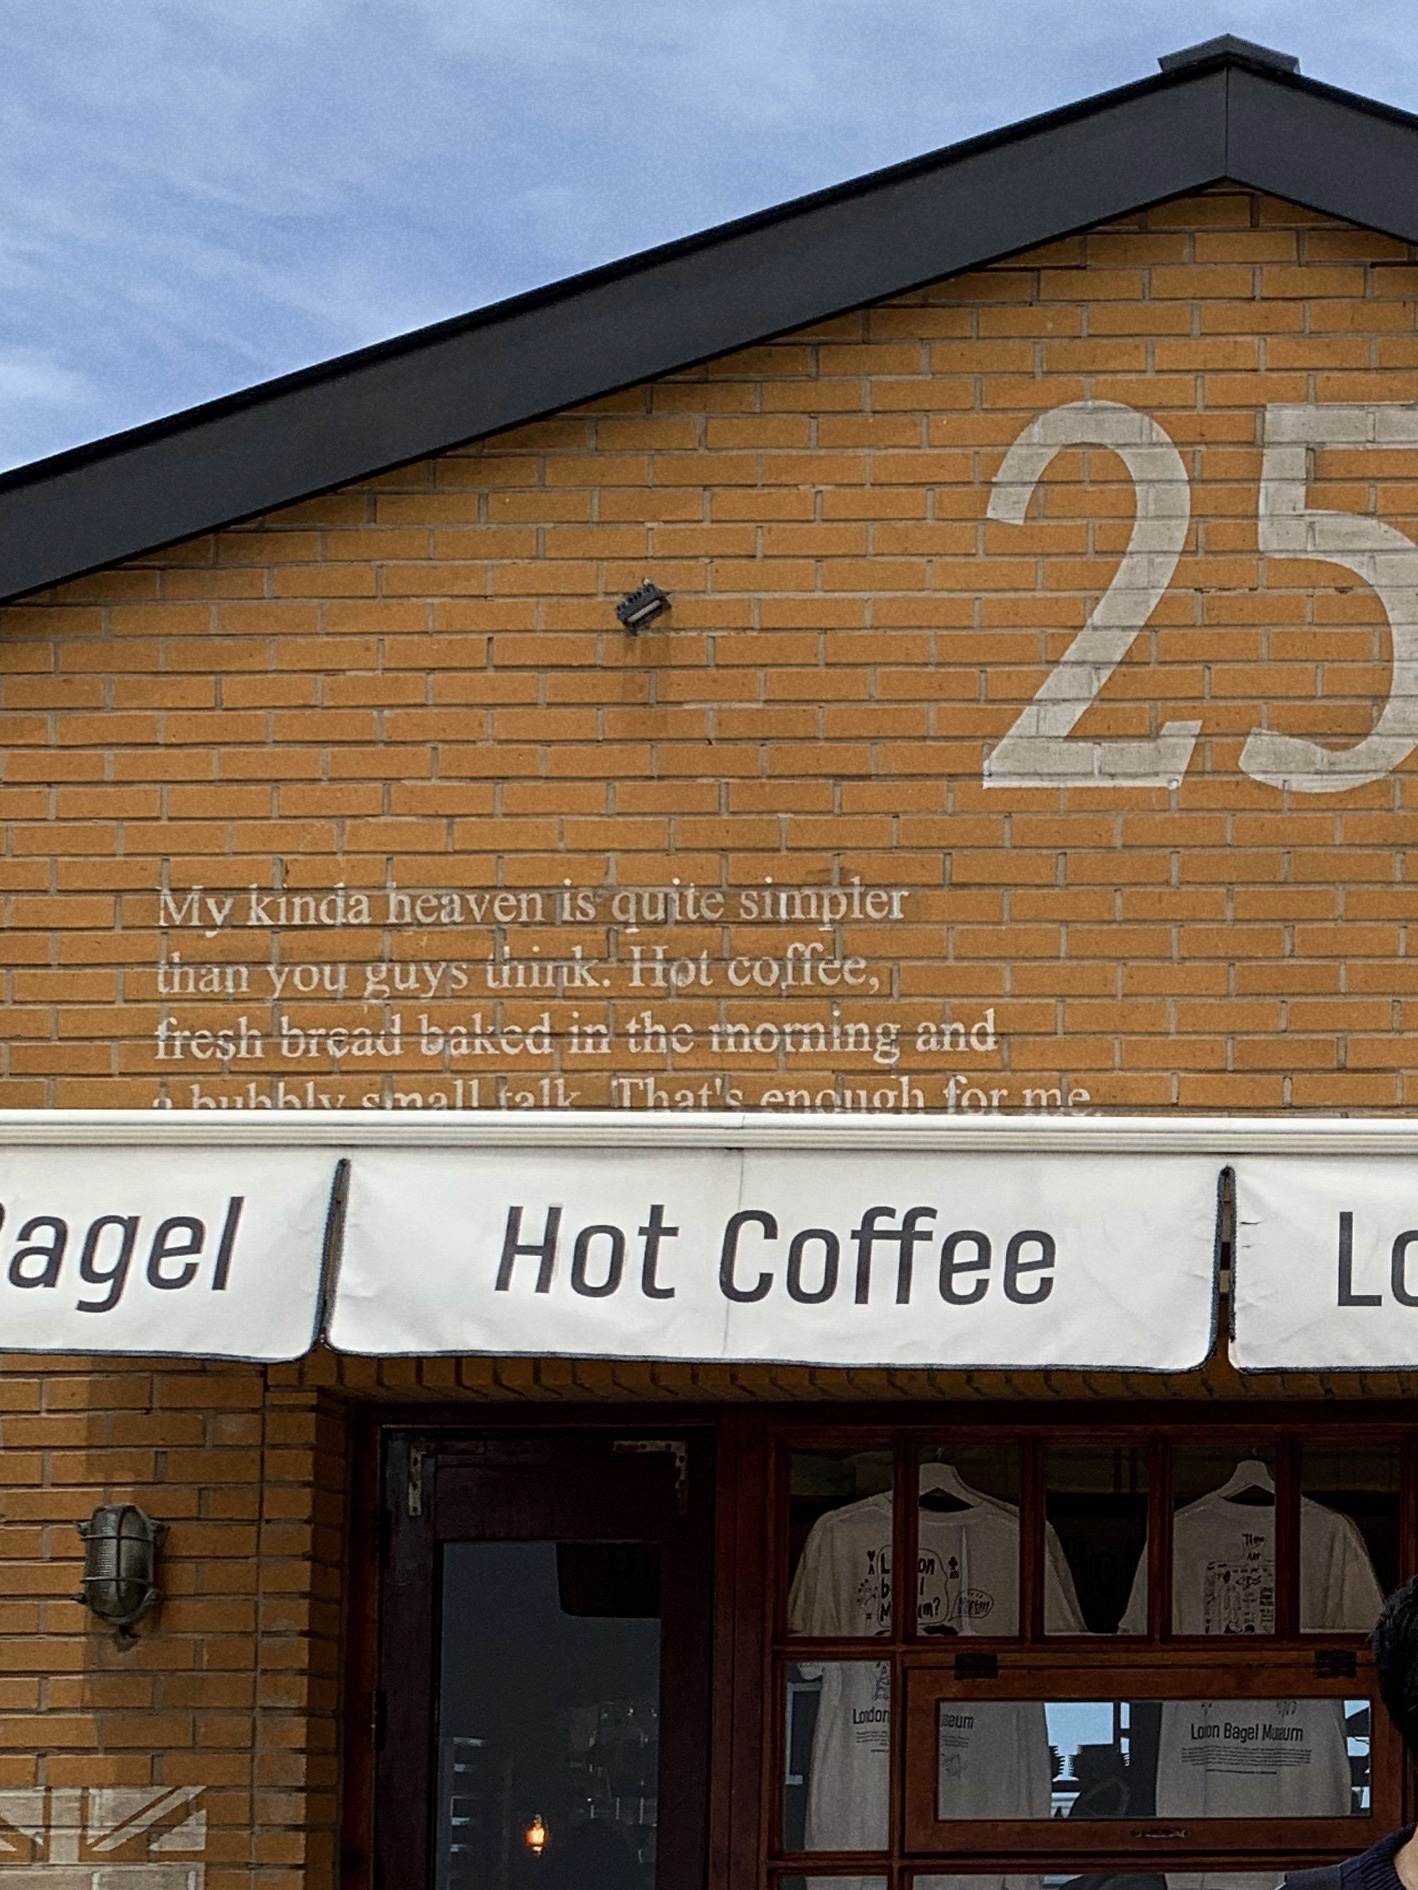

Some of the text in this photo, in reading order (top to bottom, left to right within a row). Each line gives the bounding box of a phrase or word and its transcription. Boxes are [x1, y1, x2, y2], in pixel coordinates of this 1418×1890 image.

[158, 875, 910, 937] My kinda heaven is quite simpler
[157, 941, 881, 1002] than you guys think. Hot coffee,
[154, 1008, 998, 1064] fresh bread baked in the morning and
[611, 1077, 744, 1112] That's
[760, 1076, 925, 1113] enough
[943, 1074, 1009, 1114] for
[0, 1196, 245, 1313] agel
[494, 1202, 680, 1299] Hot
[718, 1205, 1058, 1306] Coffee
[881, 1553, 935, 1575] Lon
[1224, 1722, 1259, 1743] Bagel
